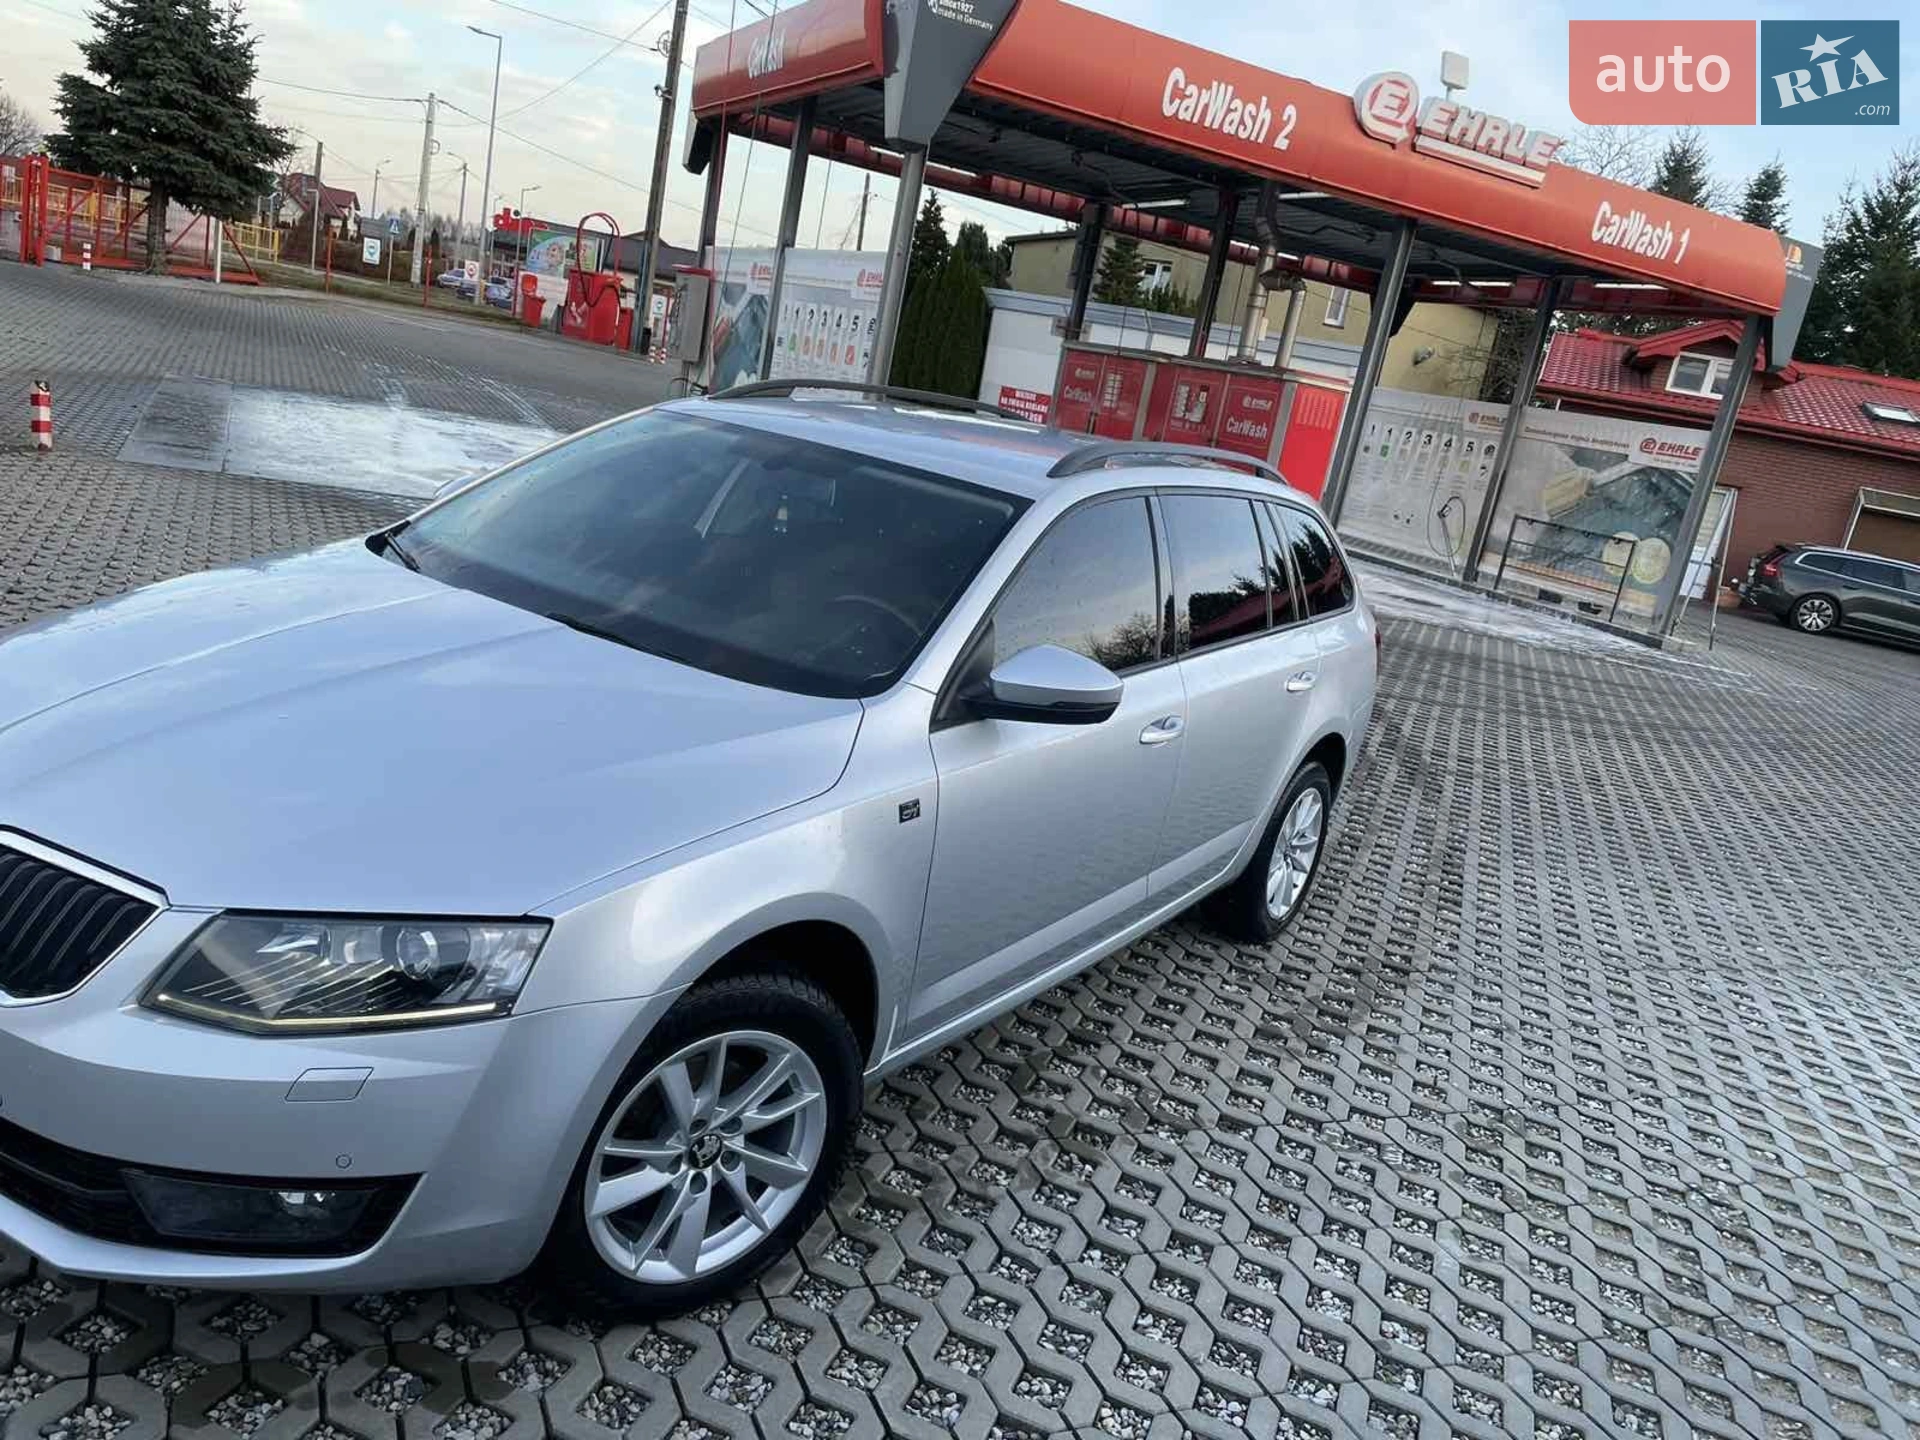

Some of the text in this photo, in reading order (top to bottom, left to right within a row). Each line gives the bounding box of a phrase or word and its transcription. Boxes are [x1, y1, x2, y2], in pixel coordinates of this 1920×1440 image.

[1162, 66, 1297, 151] CarWash 2
[1420, 97, 1562, 169] EHRLE
[1591, 200, 1691, 265] CarWash 1
[851, 315, 860, 332] 5
[1226, 416, 1268, 440] CarWash
[1386, 427, 1393, 441] 1
[1403, 430, 1413, 445] 2
[1423, 434, 1433, 446] 3
[1443, 437, 1453, 451] 4
[1465, 441, 1475, 453] 5
[1658, 441, 1702, 457] EHRLE
